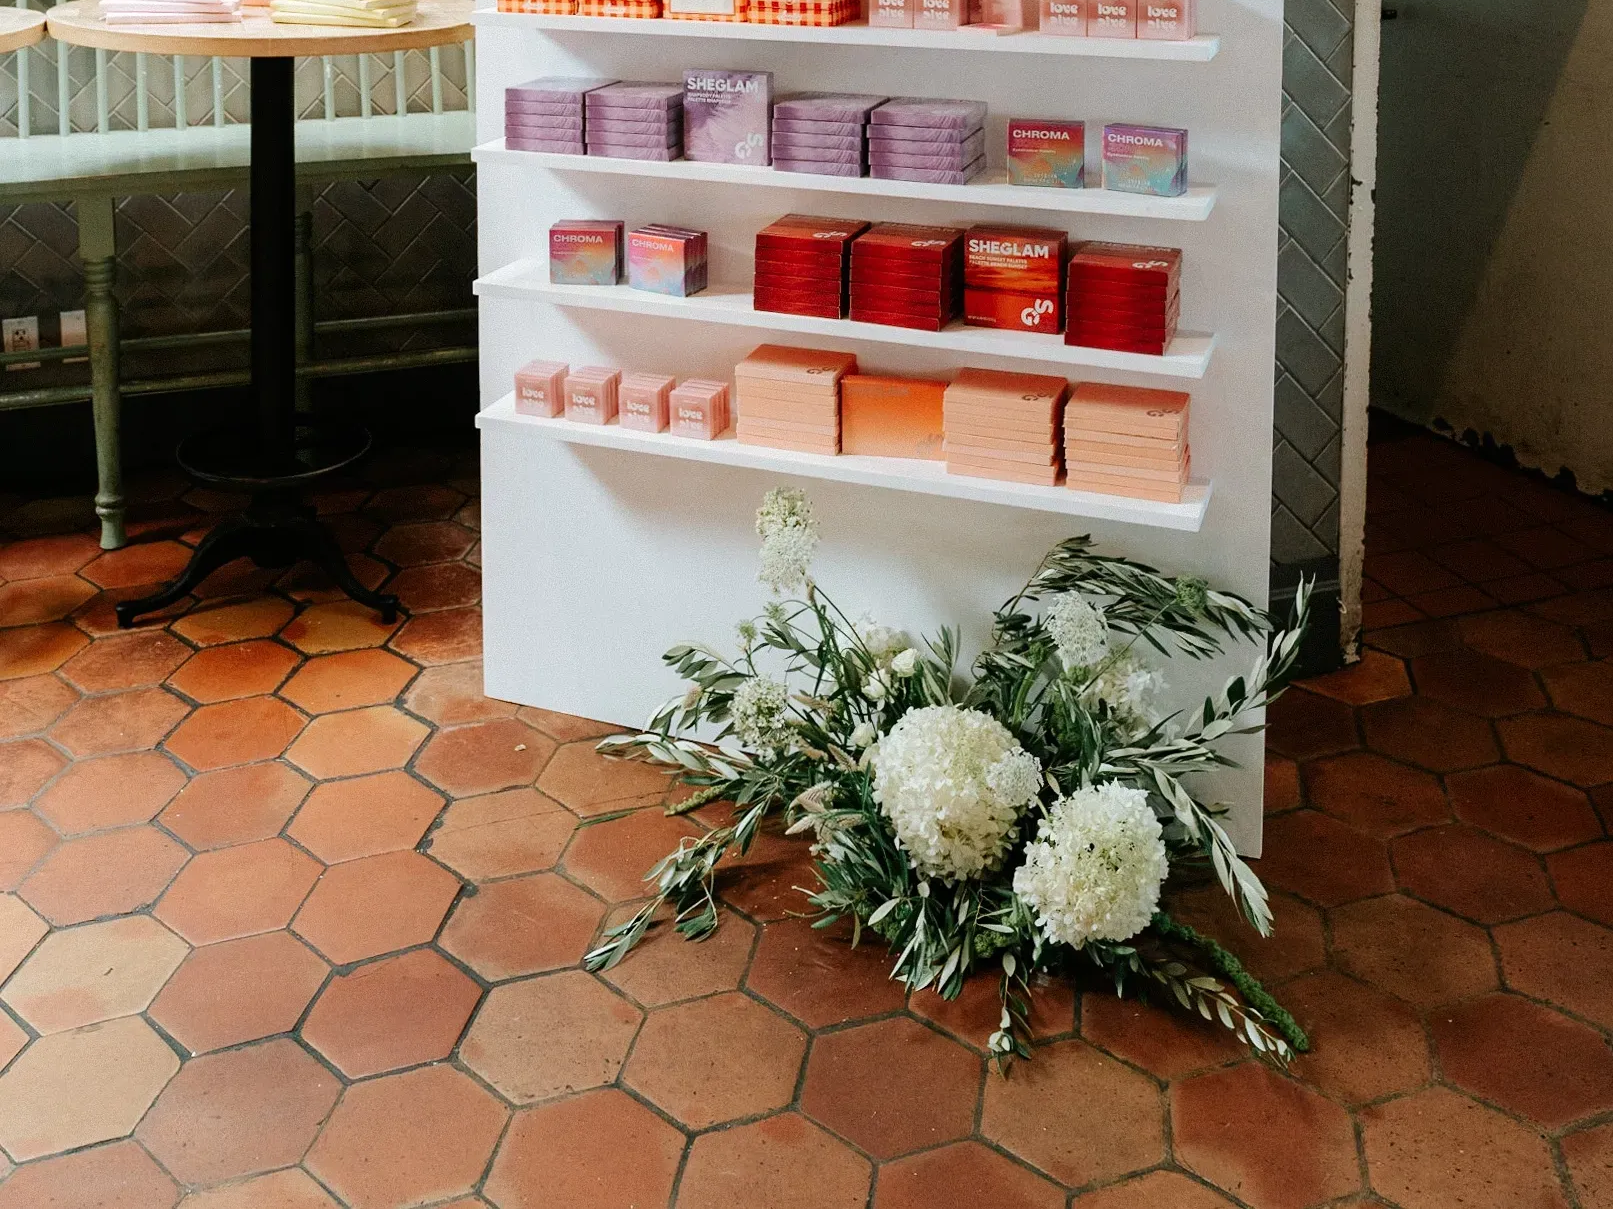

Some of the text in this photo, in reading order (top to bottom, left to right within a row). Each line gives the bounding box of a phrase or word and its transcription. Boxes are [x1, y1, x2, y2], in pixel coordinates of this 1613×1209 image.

[687, 77, 758, 93] SHEGLAM
[1013, 129, 1070, 140] CHROMA
[1108, 134, 1163, 147] CHROMA
[553, 234, 603, 244] CHROMA
[631, 238, 674, 252] CHROMA
[969, 239, 1049, 259] SHEGLAM
